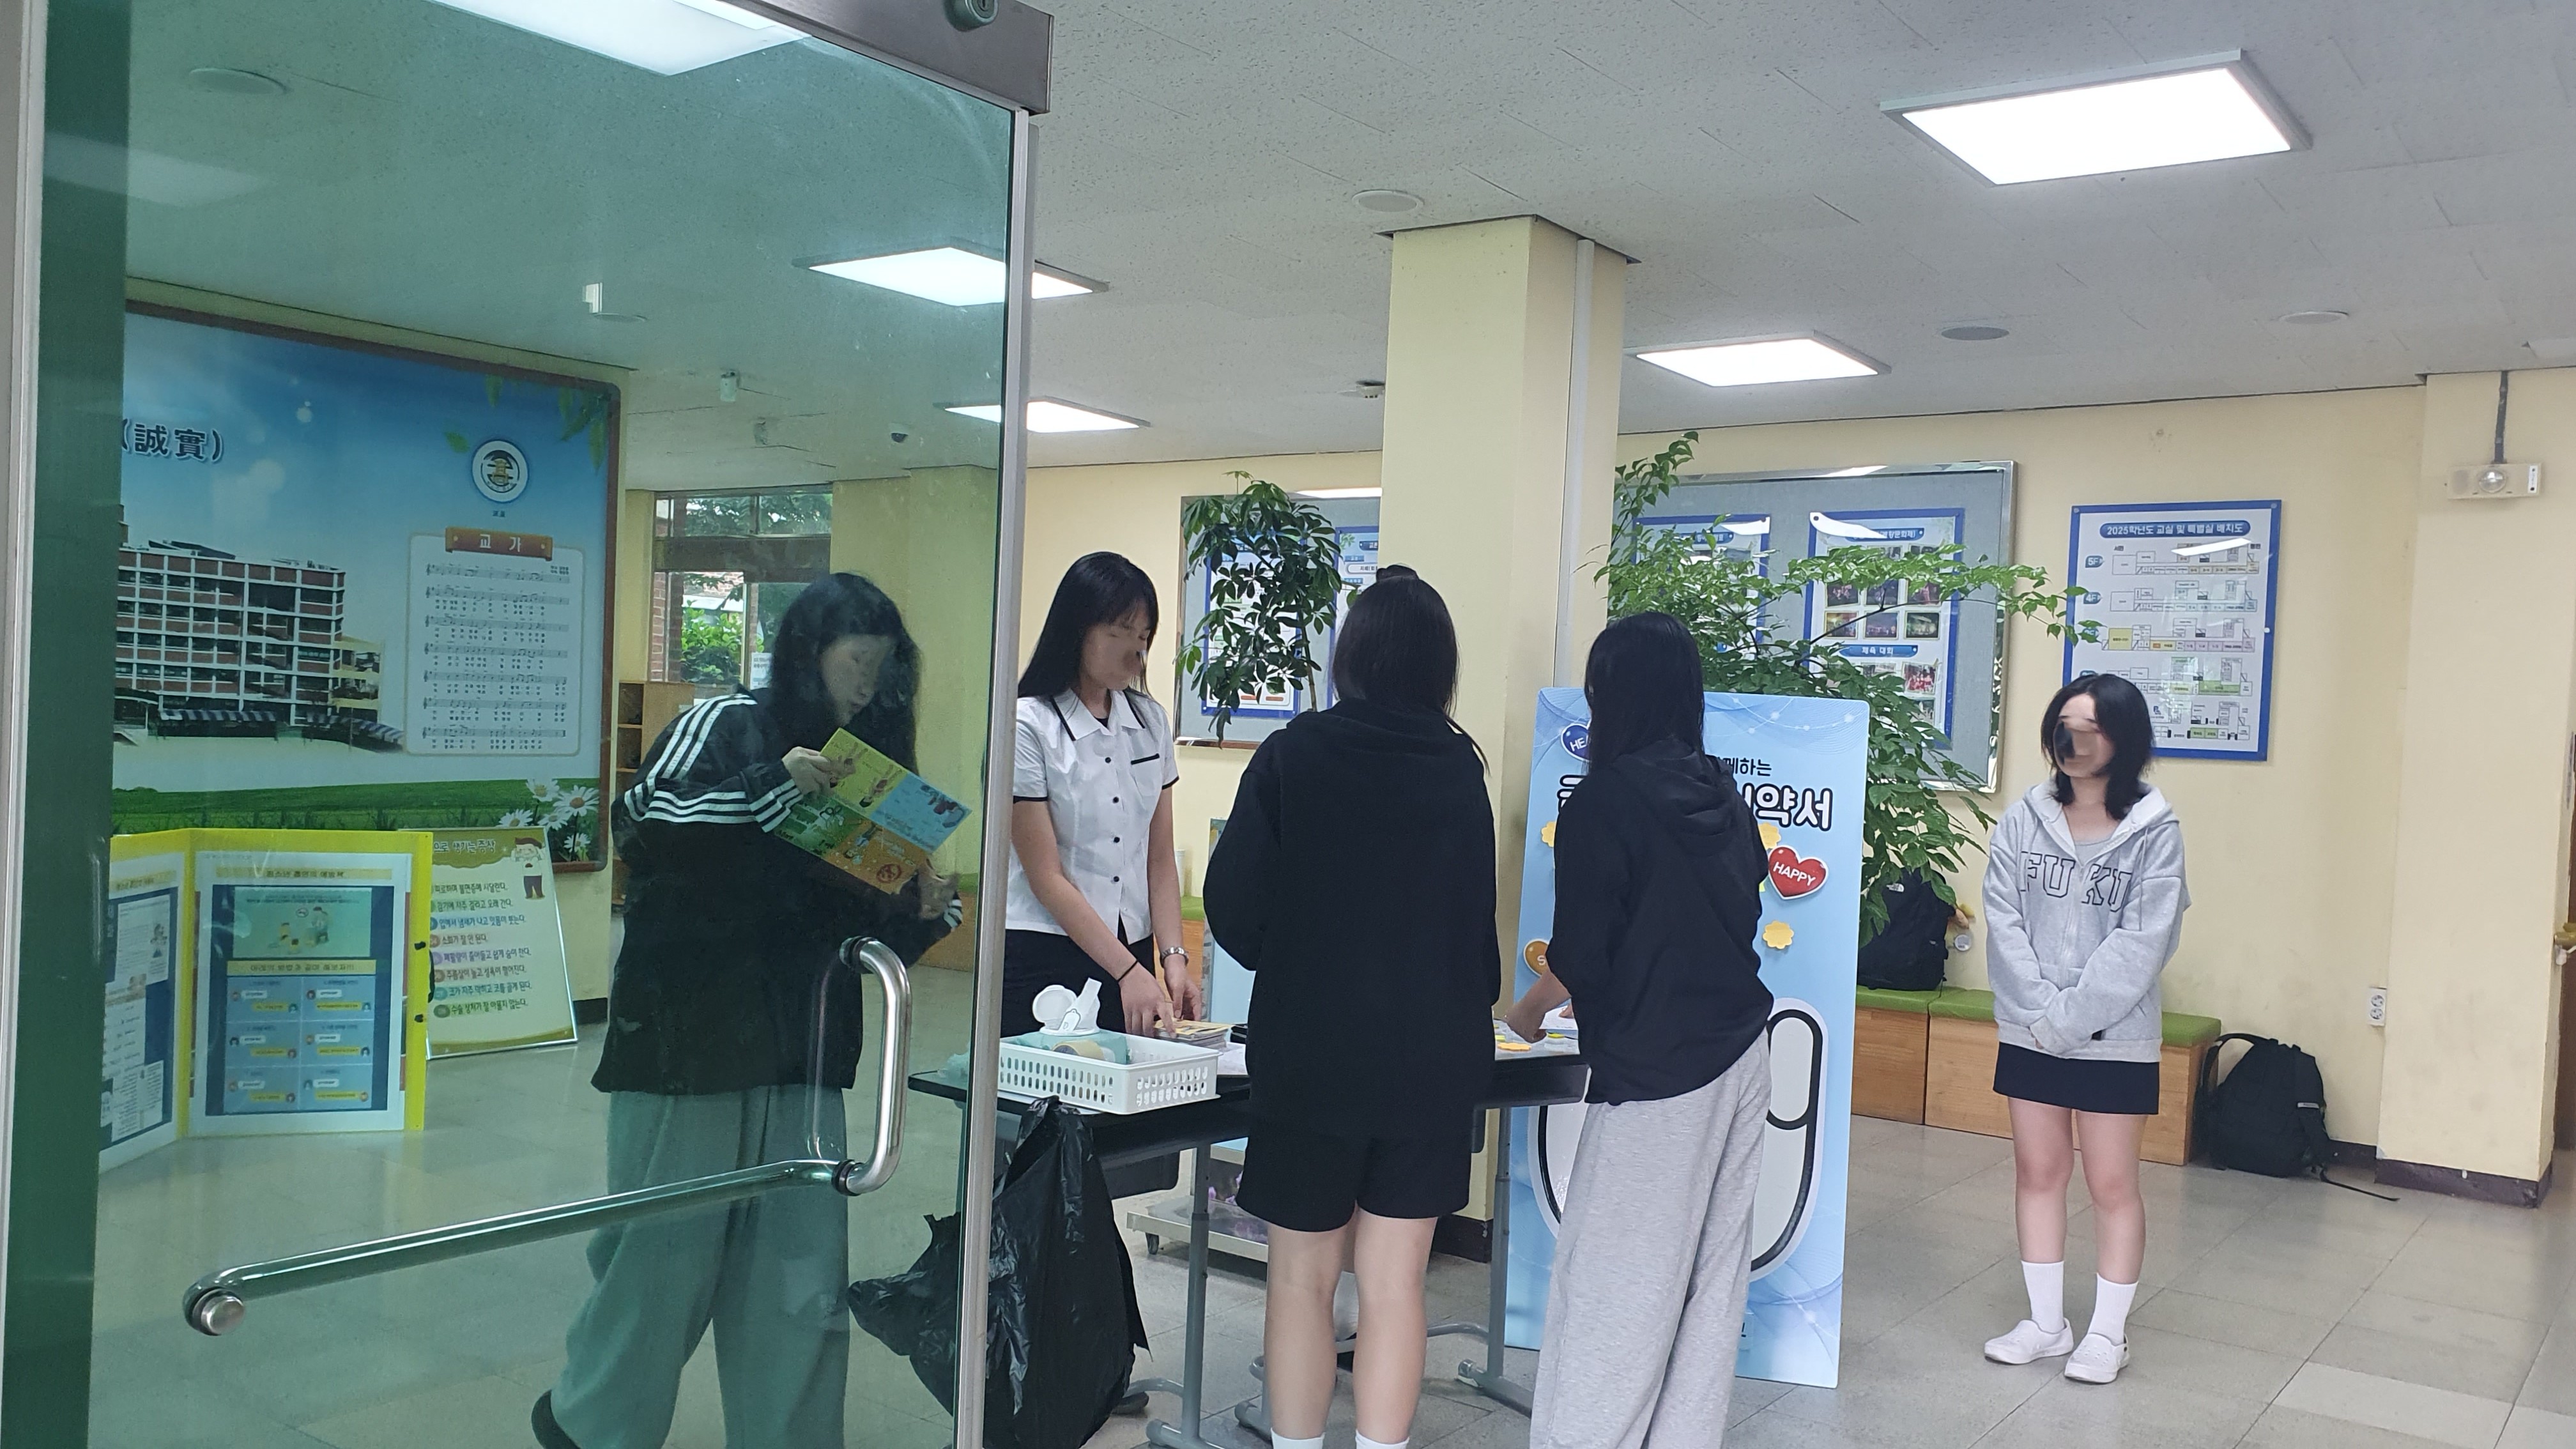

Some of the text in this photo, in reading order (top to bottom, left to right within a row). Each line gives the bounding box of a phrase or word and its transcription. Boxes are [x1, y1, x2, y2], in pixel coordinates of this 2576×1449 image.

[2107, 523, 2244, 535] 2025학년도 교실 및 특별실 배치도
[1722, 758, 1772, 776] 께하는
[1742, 783, 1833, 831] 약서
[453, 840, 477, 854] 생기는
[478, 839, 496, 854] 증상
[1773, 861, 1816, 886] HAPPY
